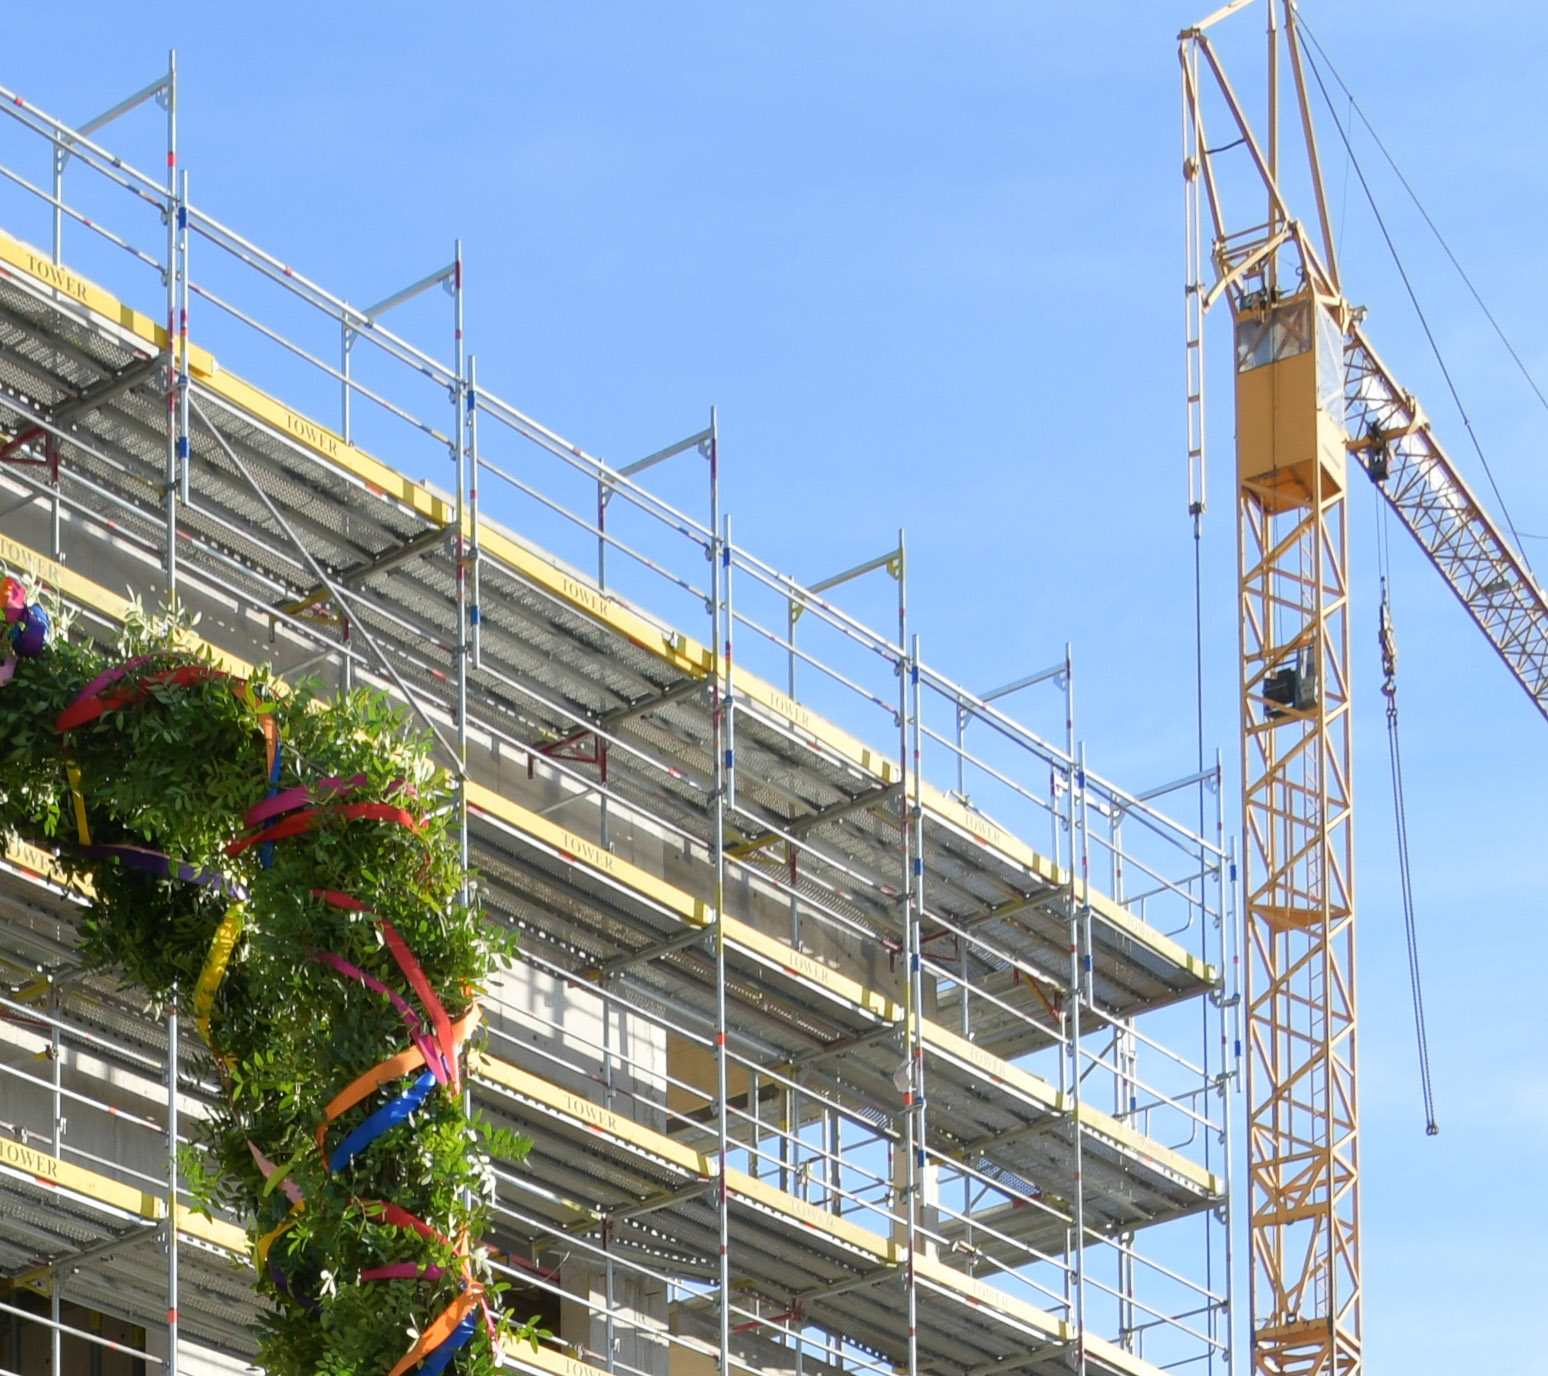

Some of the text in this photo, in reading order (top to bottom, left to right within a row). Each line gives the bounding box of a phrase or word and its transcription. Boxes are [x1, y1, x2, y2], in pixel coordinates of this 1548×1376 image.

[26, 256, 89, 300] TOWER
[285, 412, 339, 454] TOWER
[560, 575, 609, 616] TOWER
[768, 691, 809, 727] TOWER
[562, 831, 613, 870] TOWER
[563, 1092, 618, 1131] TOWER
